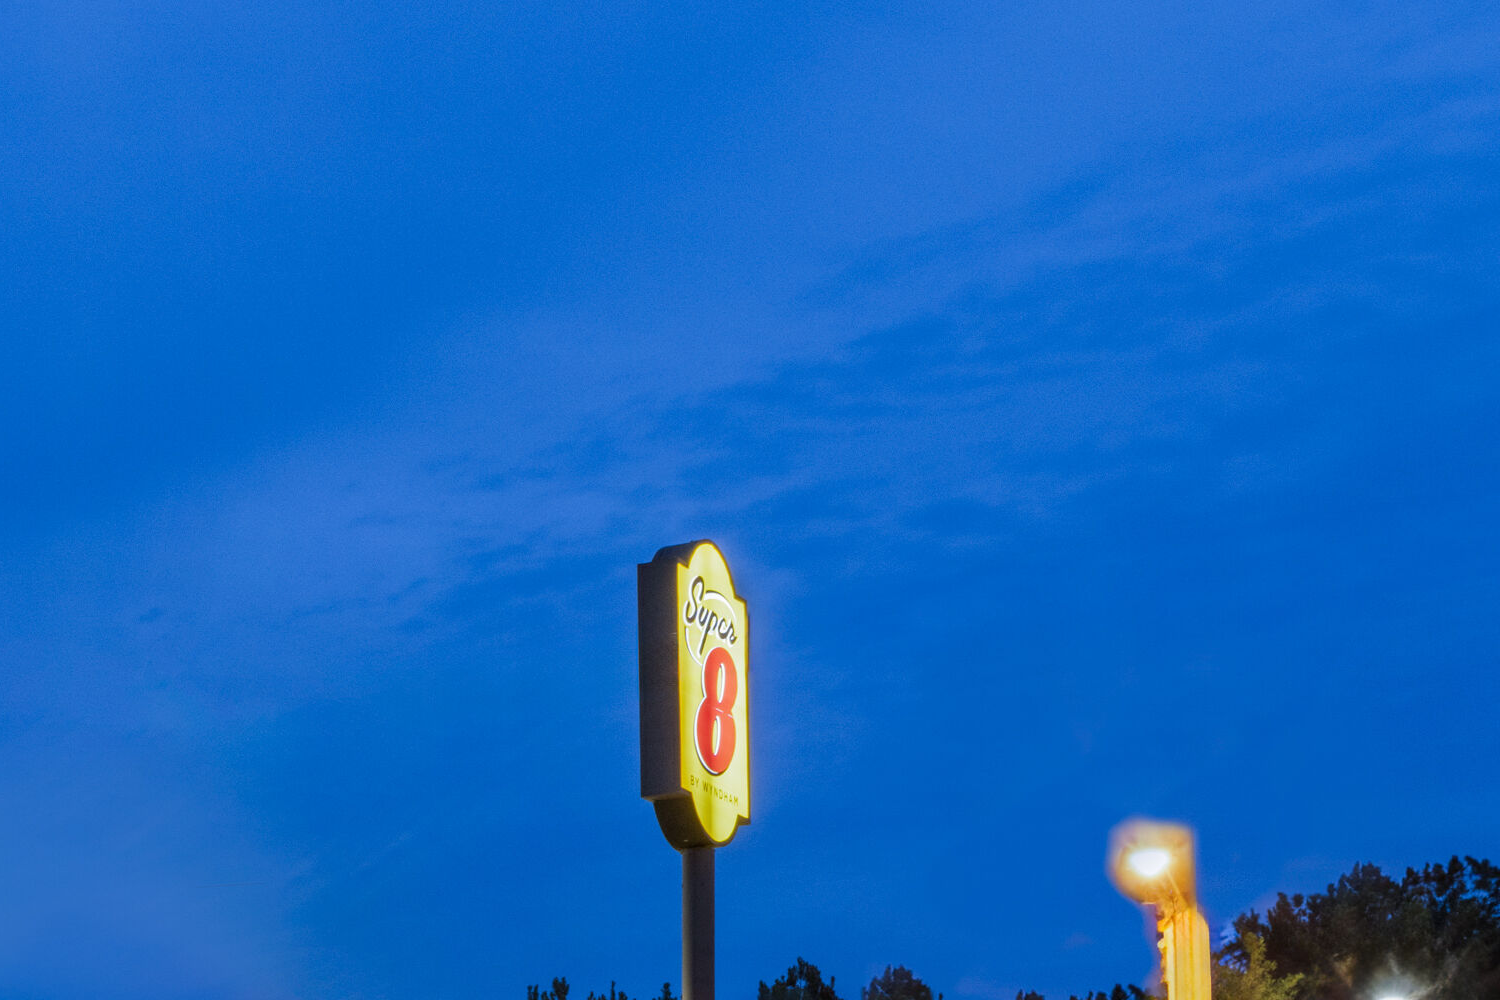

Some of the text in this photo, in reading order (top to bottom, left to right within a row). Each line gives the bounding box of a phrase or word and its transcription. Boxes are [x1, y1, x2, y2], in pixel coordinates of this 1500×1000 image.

[684, 575, 737, 657] Super
[693, 646, 738, 775] 8
[690, 775, 739, 806] BY WYNDHAM
